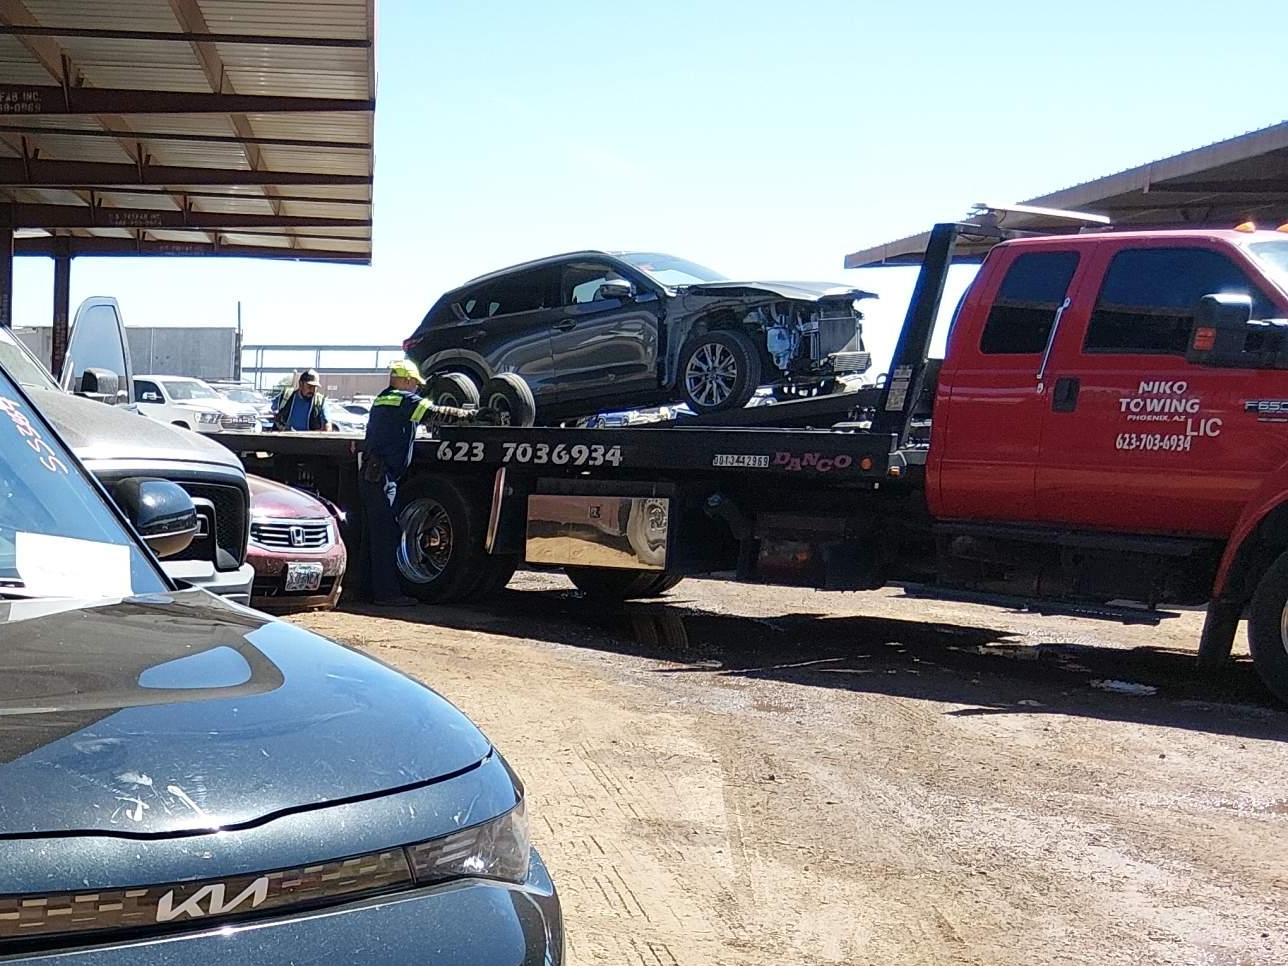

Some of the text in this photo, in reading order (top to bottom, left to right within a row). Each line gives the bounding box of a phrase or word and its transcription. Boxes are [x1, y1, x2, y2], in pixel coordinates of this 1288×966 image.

[1137, 380, 1188, 395] NIKO
[1118, 398, 1201, 414] TOWING
[1115, 432, 1192, 451] 623-703-6934
[436, 441, 623, 467] 623 7036934
[774, 452, 853, 472] DANCO
[156, 877, 269, 922] KIA
